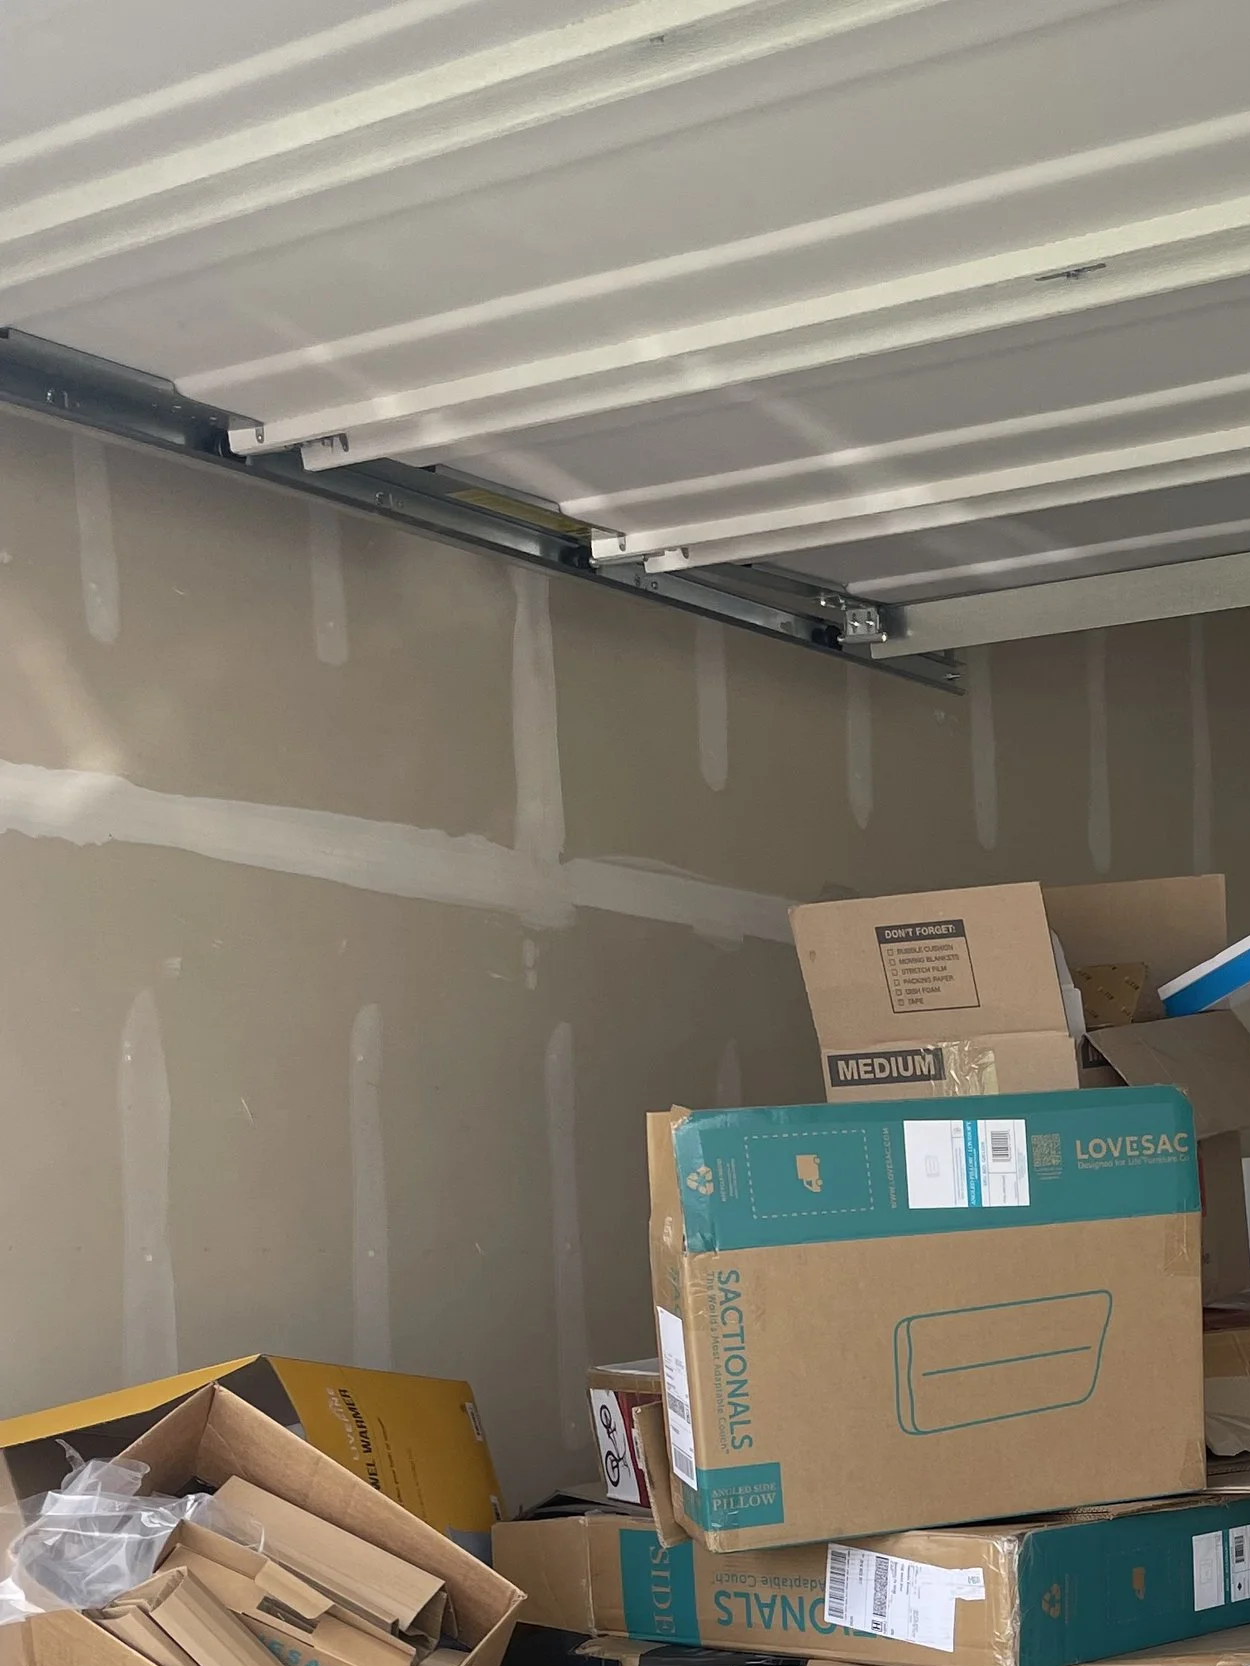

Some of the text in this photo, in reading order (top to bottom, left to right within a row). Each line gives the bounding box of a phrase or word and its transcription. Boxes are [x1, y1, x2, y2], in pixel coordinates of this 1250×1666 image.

[885, 927, 913, 939] DON'T
[923, 944, 954, 953] CUSHION
[837, 1054, 936, 1081] MEDIUM
[1076, 1132, 1189, 1160] LOVESAC
[1077, 1158, 1114, 1170] Designed
[706, 1272, 715, 1292] The
[711, 1335, 720, 1361] Most
[717, 1269, 753, 1451] SACTIONALS
[713, 1363, 724, 1414] Adaptable
[339, 1388, 372, 1454] WARMER
[711, 1482, 777, 1498] ANGLED SIDE
[712, 1492, 776, 1512] PILLOW
[649, 1545, 676, 1634] SIDE
